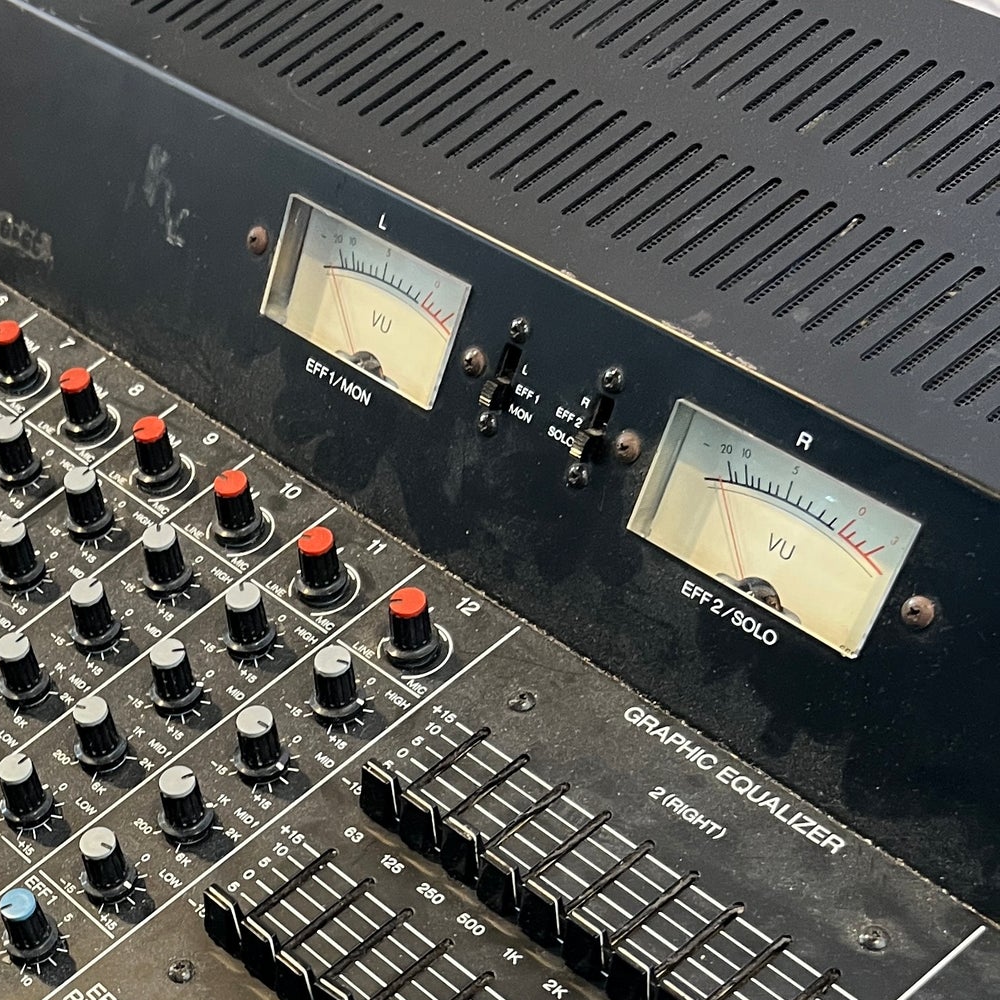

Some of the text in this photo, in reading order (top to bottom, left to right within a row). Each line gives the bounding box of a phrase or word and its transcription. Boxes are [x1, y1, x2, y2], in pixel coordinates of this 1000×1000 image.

[378, 214, 387, 231] L
[371, 310, 393, 334] VU
[521, 363, 528, 376] L
[128, 383, 144, 398] 8
[305, 357, 371, 407] EFF1/MON
[580, 396, 591, 409] R
[508, 403, 532, 424] MON
[202, 432, 219, 446] 9
[796, 431, 813, 450] R
[280, 482, 302, 500] 10
[366, 538, 387, 556] 11
[768, 532, 796, 560] VU
[265, 579, 287, 599] LINE
[456, 596, 481, 617] 12
[144, 623, 163, 639] MID
[315, 614, 336, 632] MIC
[294, 626, 319, 646] HIGH
[352, 641, 375, 660] LINE
[225, 684, 246, 702] MID
[406, 677, 428, 696] MIC
[384, 689, 412, 710] HIGH
[432, 702, 455, 723] +15
[425, 722, 441, 736] 10
[411, 735, 422, 747] 5
[315, 751, 335, 769] MID
[396, 747, 408, 760] 0
[623, 706, 846, 854] GRAPHIC EQUALIZER
[75, 796, 98, 817] LOW
[133, 817, 154, 836] 200
[281, 824, 305, 846] +15
[344, 826, 364, 842] 63
[380, 854, 404, 874] 125
[158, 867, 183, 889] LOW
[416, 882, 445, 904] 250
[456, 913, 486, 936] 500
[504, 947, 523, 965] 1K
[542, 978, 568, 999] 2K
